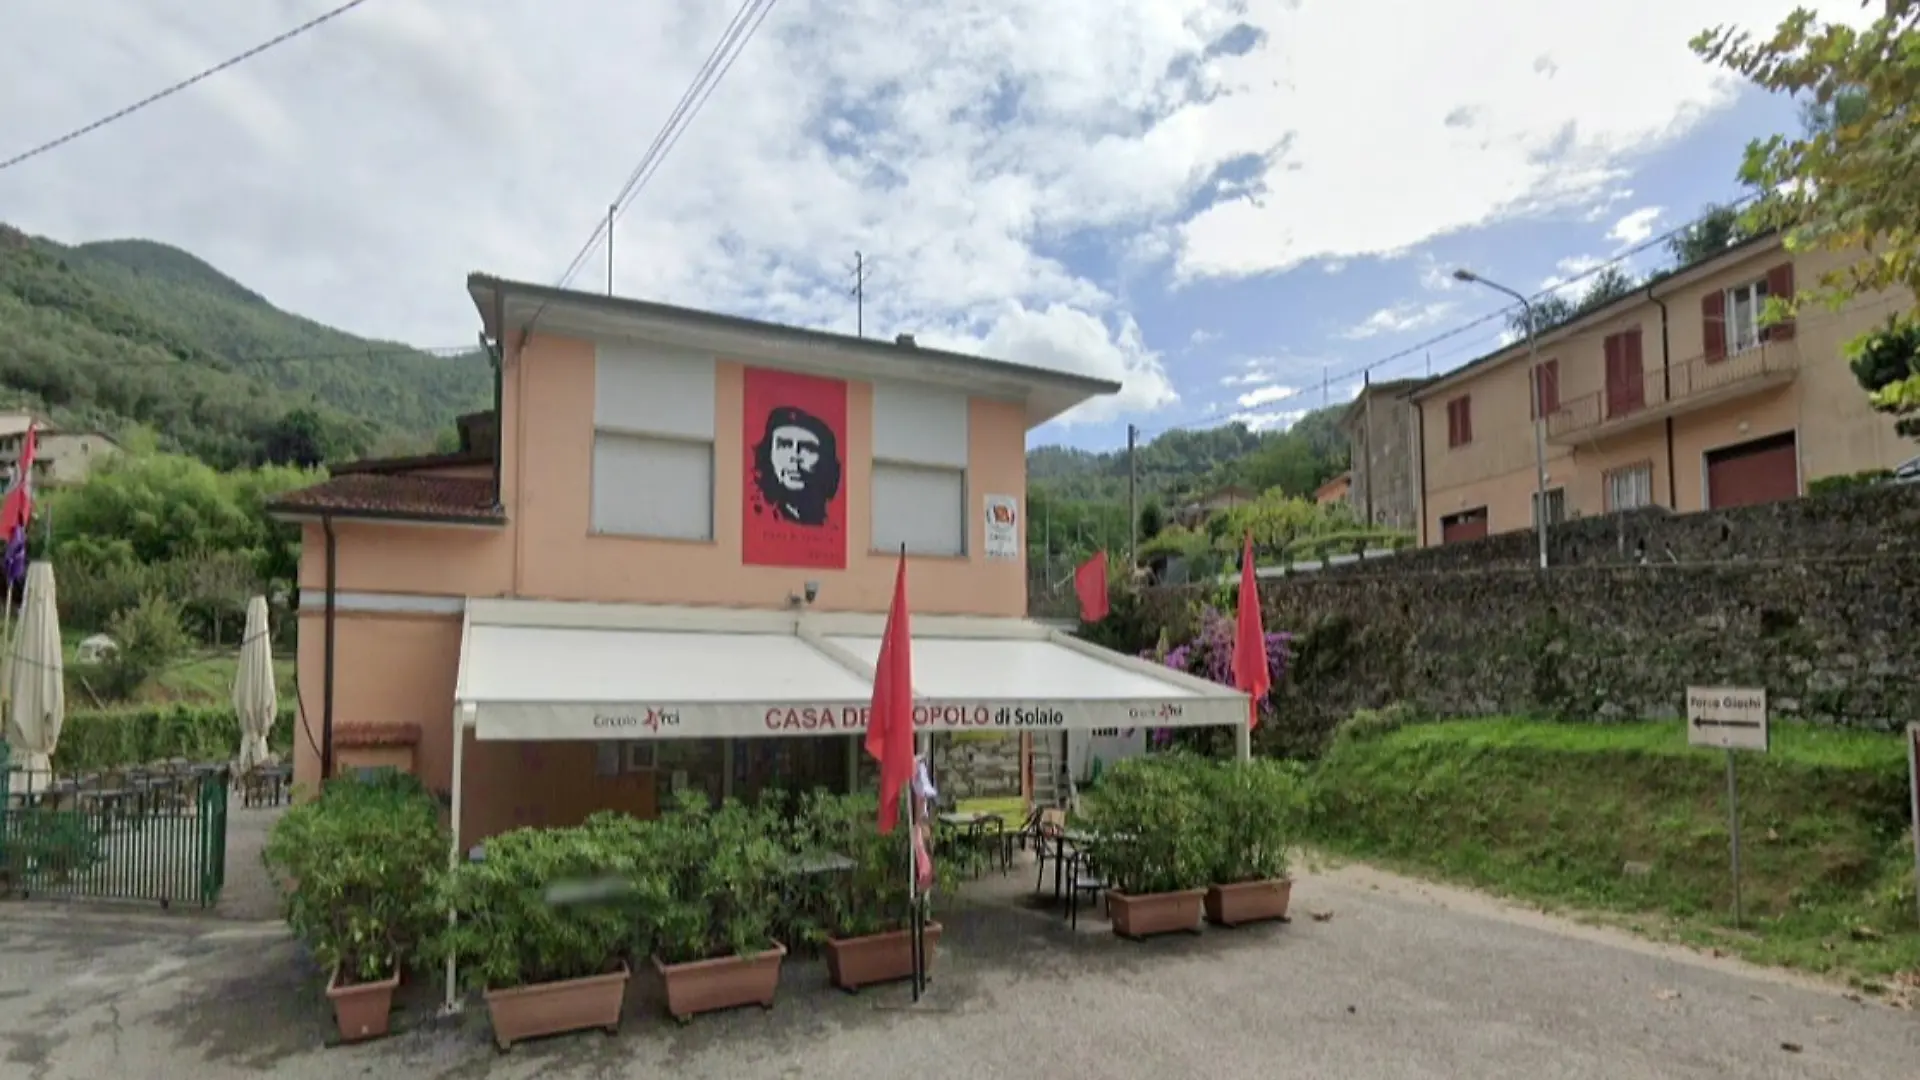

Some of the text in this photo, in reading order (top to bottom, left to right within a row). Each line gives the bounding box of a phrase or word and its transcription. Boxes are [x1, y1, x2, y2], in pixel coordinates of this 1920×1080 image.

[765, 705, 1063, 730] CASA DE OPOLO di Solaio
